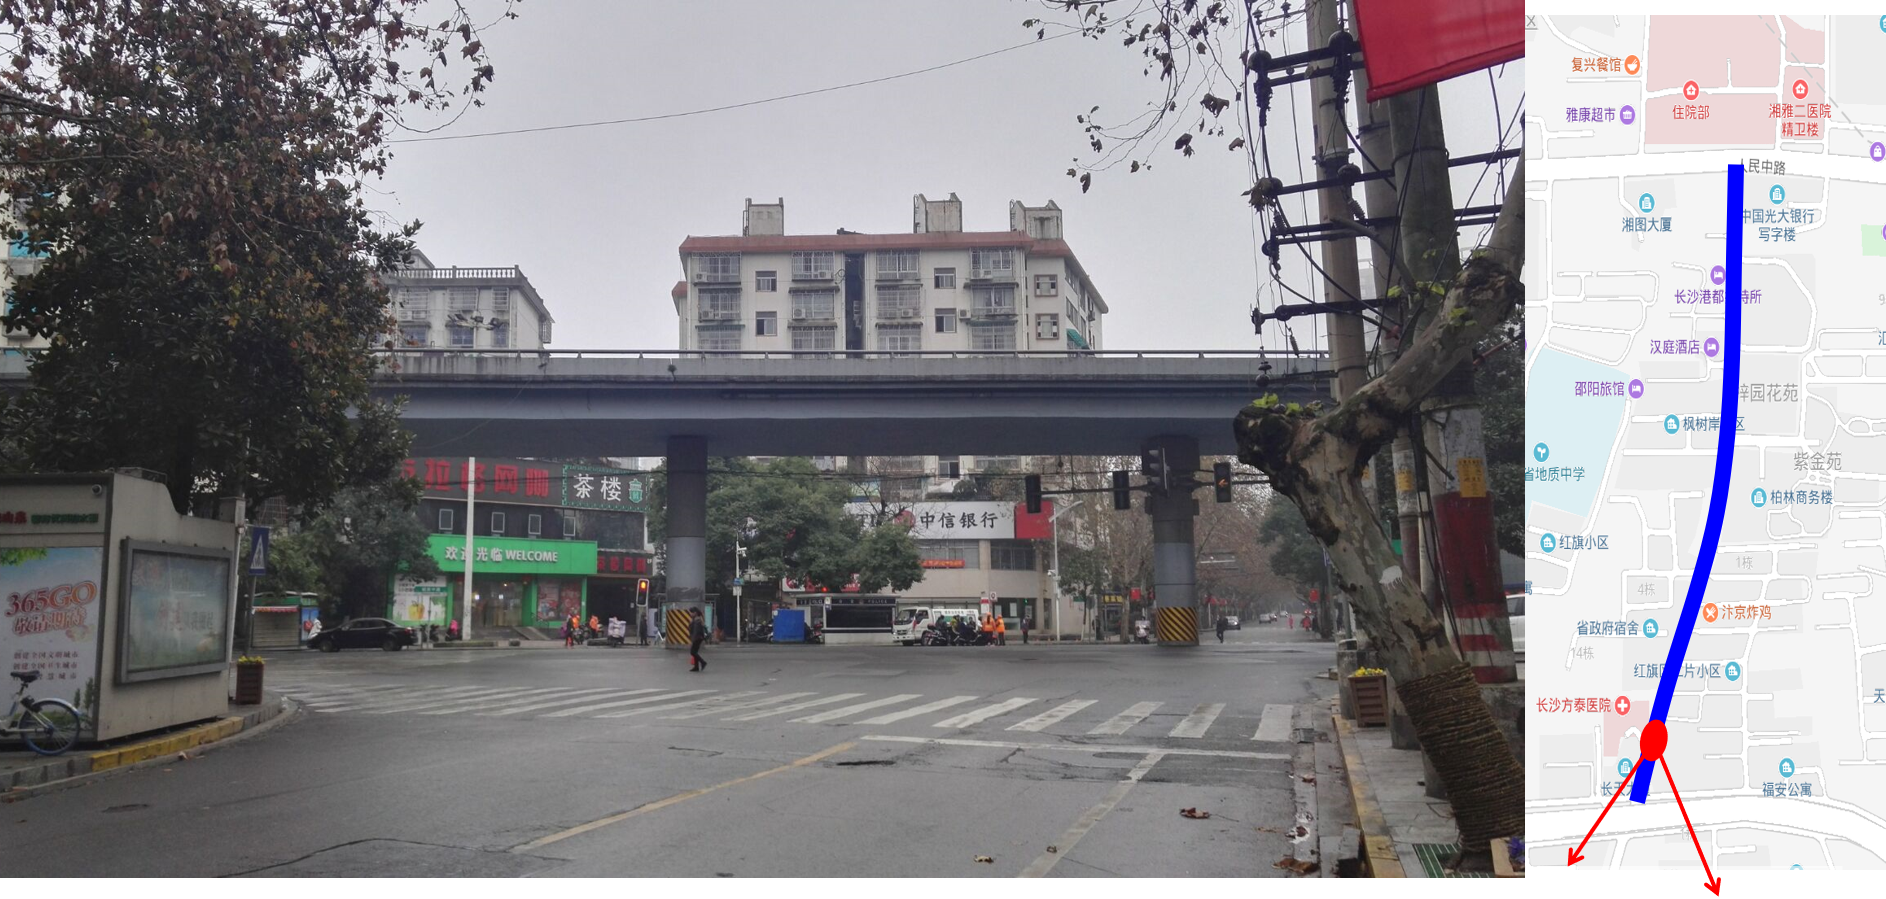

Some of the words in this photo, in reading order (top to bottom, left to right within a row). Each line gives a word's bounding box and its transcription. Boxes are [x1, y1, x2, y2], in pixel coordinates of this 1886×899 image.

[573, 473, 621, 502] 茶楼
[920, 511, 998, 529] 中信银行
[505, 549, 559, 563] WELCOME
[5, 581, 97, 616] 365GO
